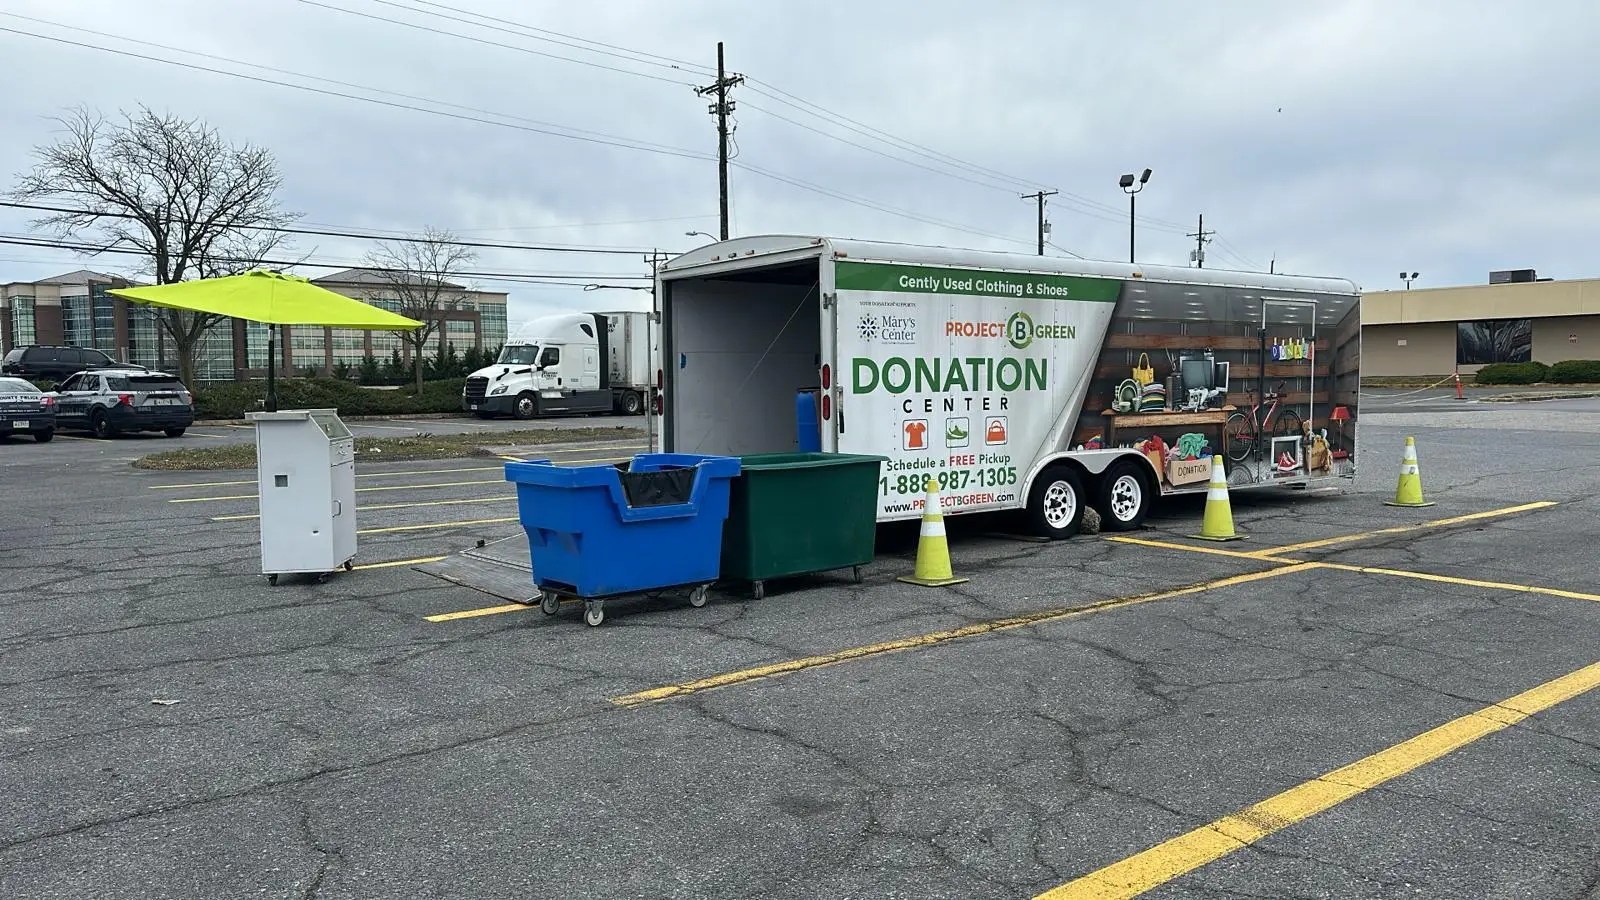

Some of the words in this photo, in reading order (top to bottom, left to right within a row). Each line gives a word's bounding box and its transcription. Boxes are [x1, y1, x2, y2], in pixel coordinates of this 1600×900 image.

[899, 275, 940, 291] Gently
[943, 277, 973, 291] Used
[975, 279, 1023, 296] Clothing
[1026, 282, 1034, 295] &
[1036, 283, 1068, 296] Shoes
[882, 315, 916, 330] Mary's
[945, 321, 1006, 338] PROJECT
[1015, 321, 1026, 340] B
[1035, 324, 1076, 339] GREEN
[881, 328, 916, 341] Center
[852, 357, 1048, 394] DONATION
[902, 397, 1009, 414] CENTER
[886, 457, 936, 472] Schedule
[939, 459, 945, 468] a
[949, 455, 975, 467] FREE
[979, 454, 1011, 466] Pickup
[879, 467, 1017, 496] 1-888987-1305
[884, 493, 1015, 513] www.PRECTBGREEN.com
